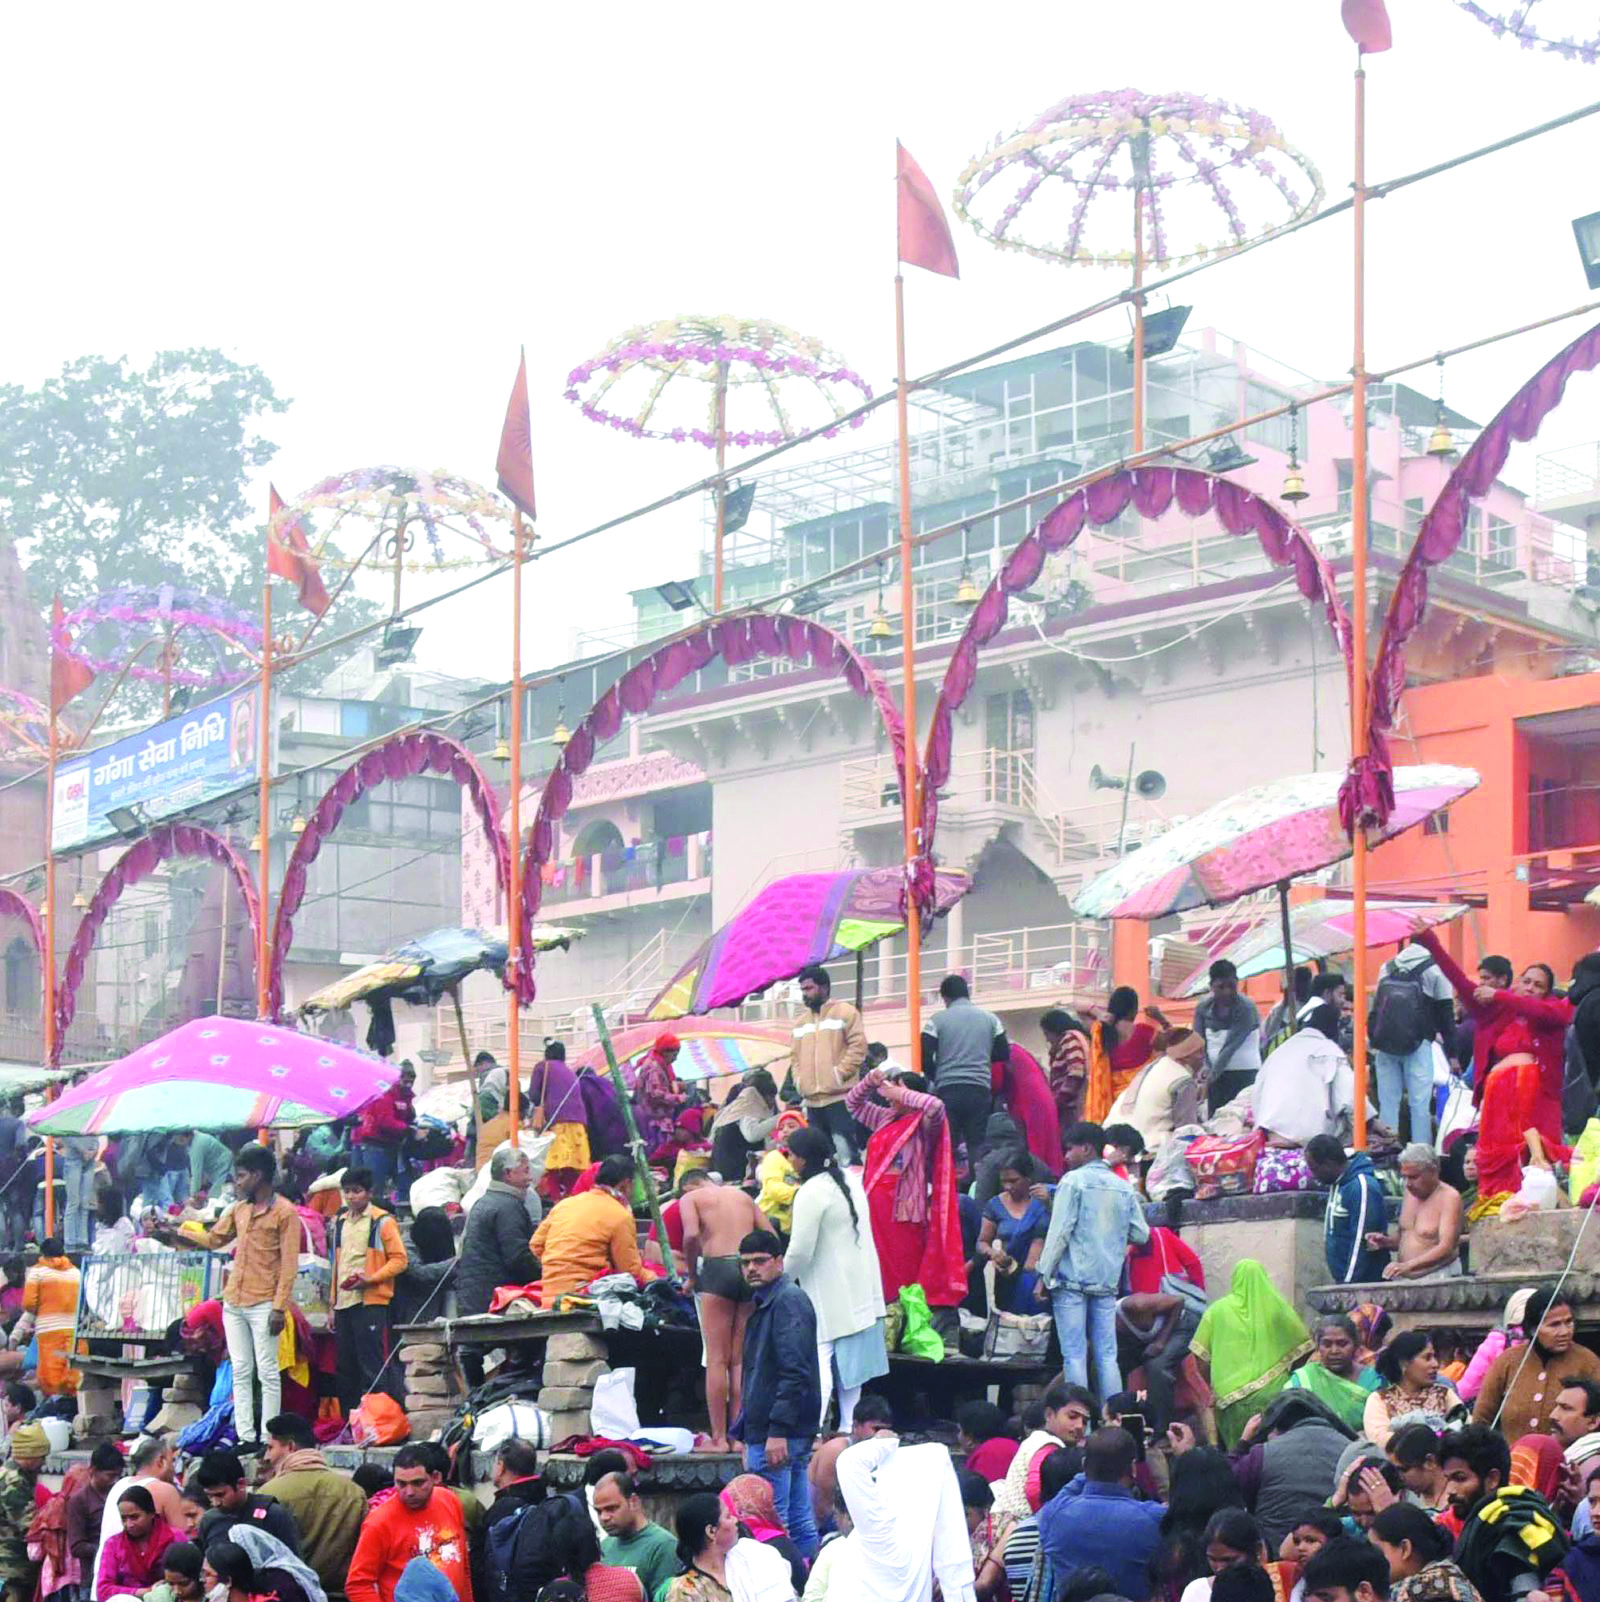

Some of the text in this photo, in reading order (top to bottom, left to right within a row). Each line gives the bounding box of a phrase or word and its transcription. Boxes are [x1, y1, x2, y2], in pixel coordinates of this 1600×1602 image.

[93, 751, 135, 786] गंगा
[138, 738, 176, 773] सेवा
[180, 711, 226, 756] निधि
